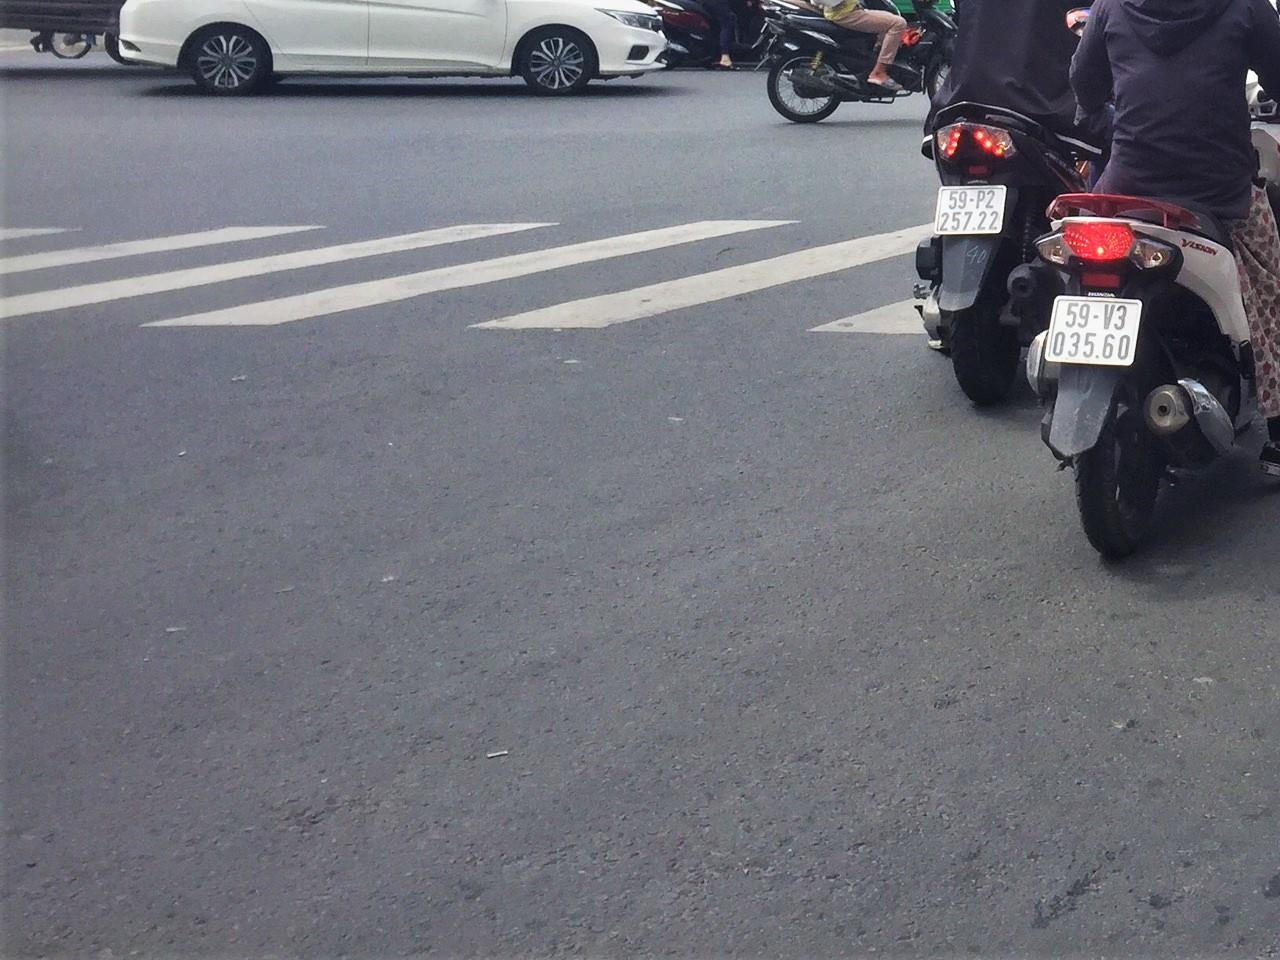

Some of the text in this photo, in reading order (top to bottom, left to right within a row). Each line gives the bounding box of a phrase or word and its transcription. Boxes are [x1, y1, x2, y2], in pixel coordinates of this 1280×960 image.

[948, 190, 996, 210] 59-P2
[939, 210, 999, 231] 257.22
[1065, 302, 1128, 331] 59-V3
[1052, 331, 1131, 360] 035.60
